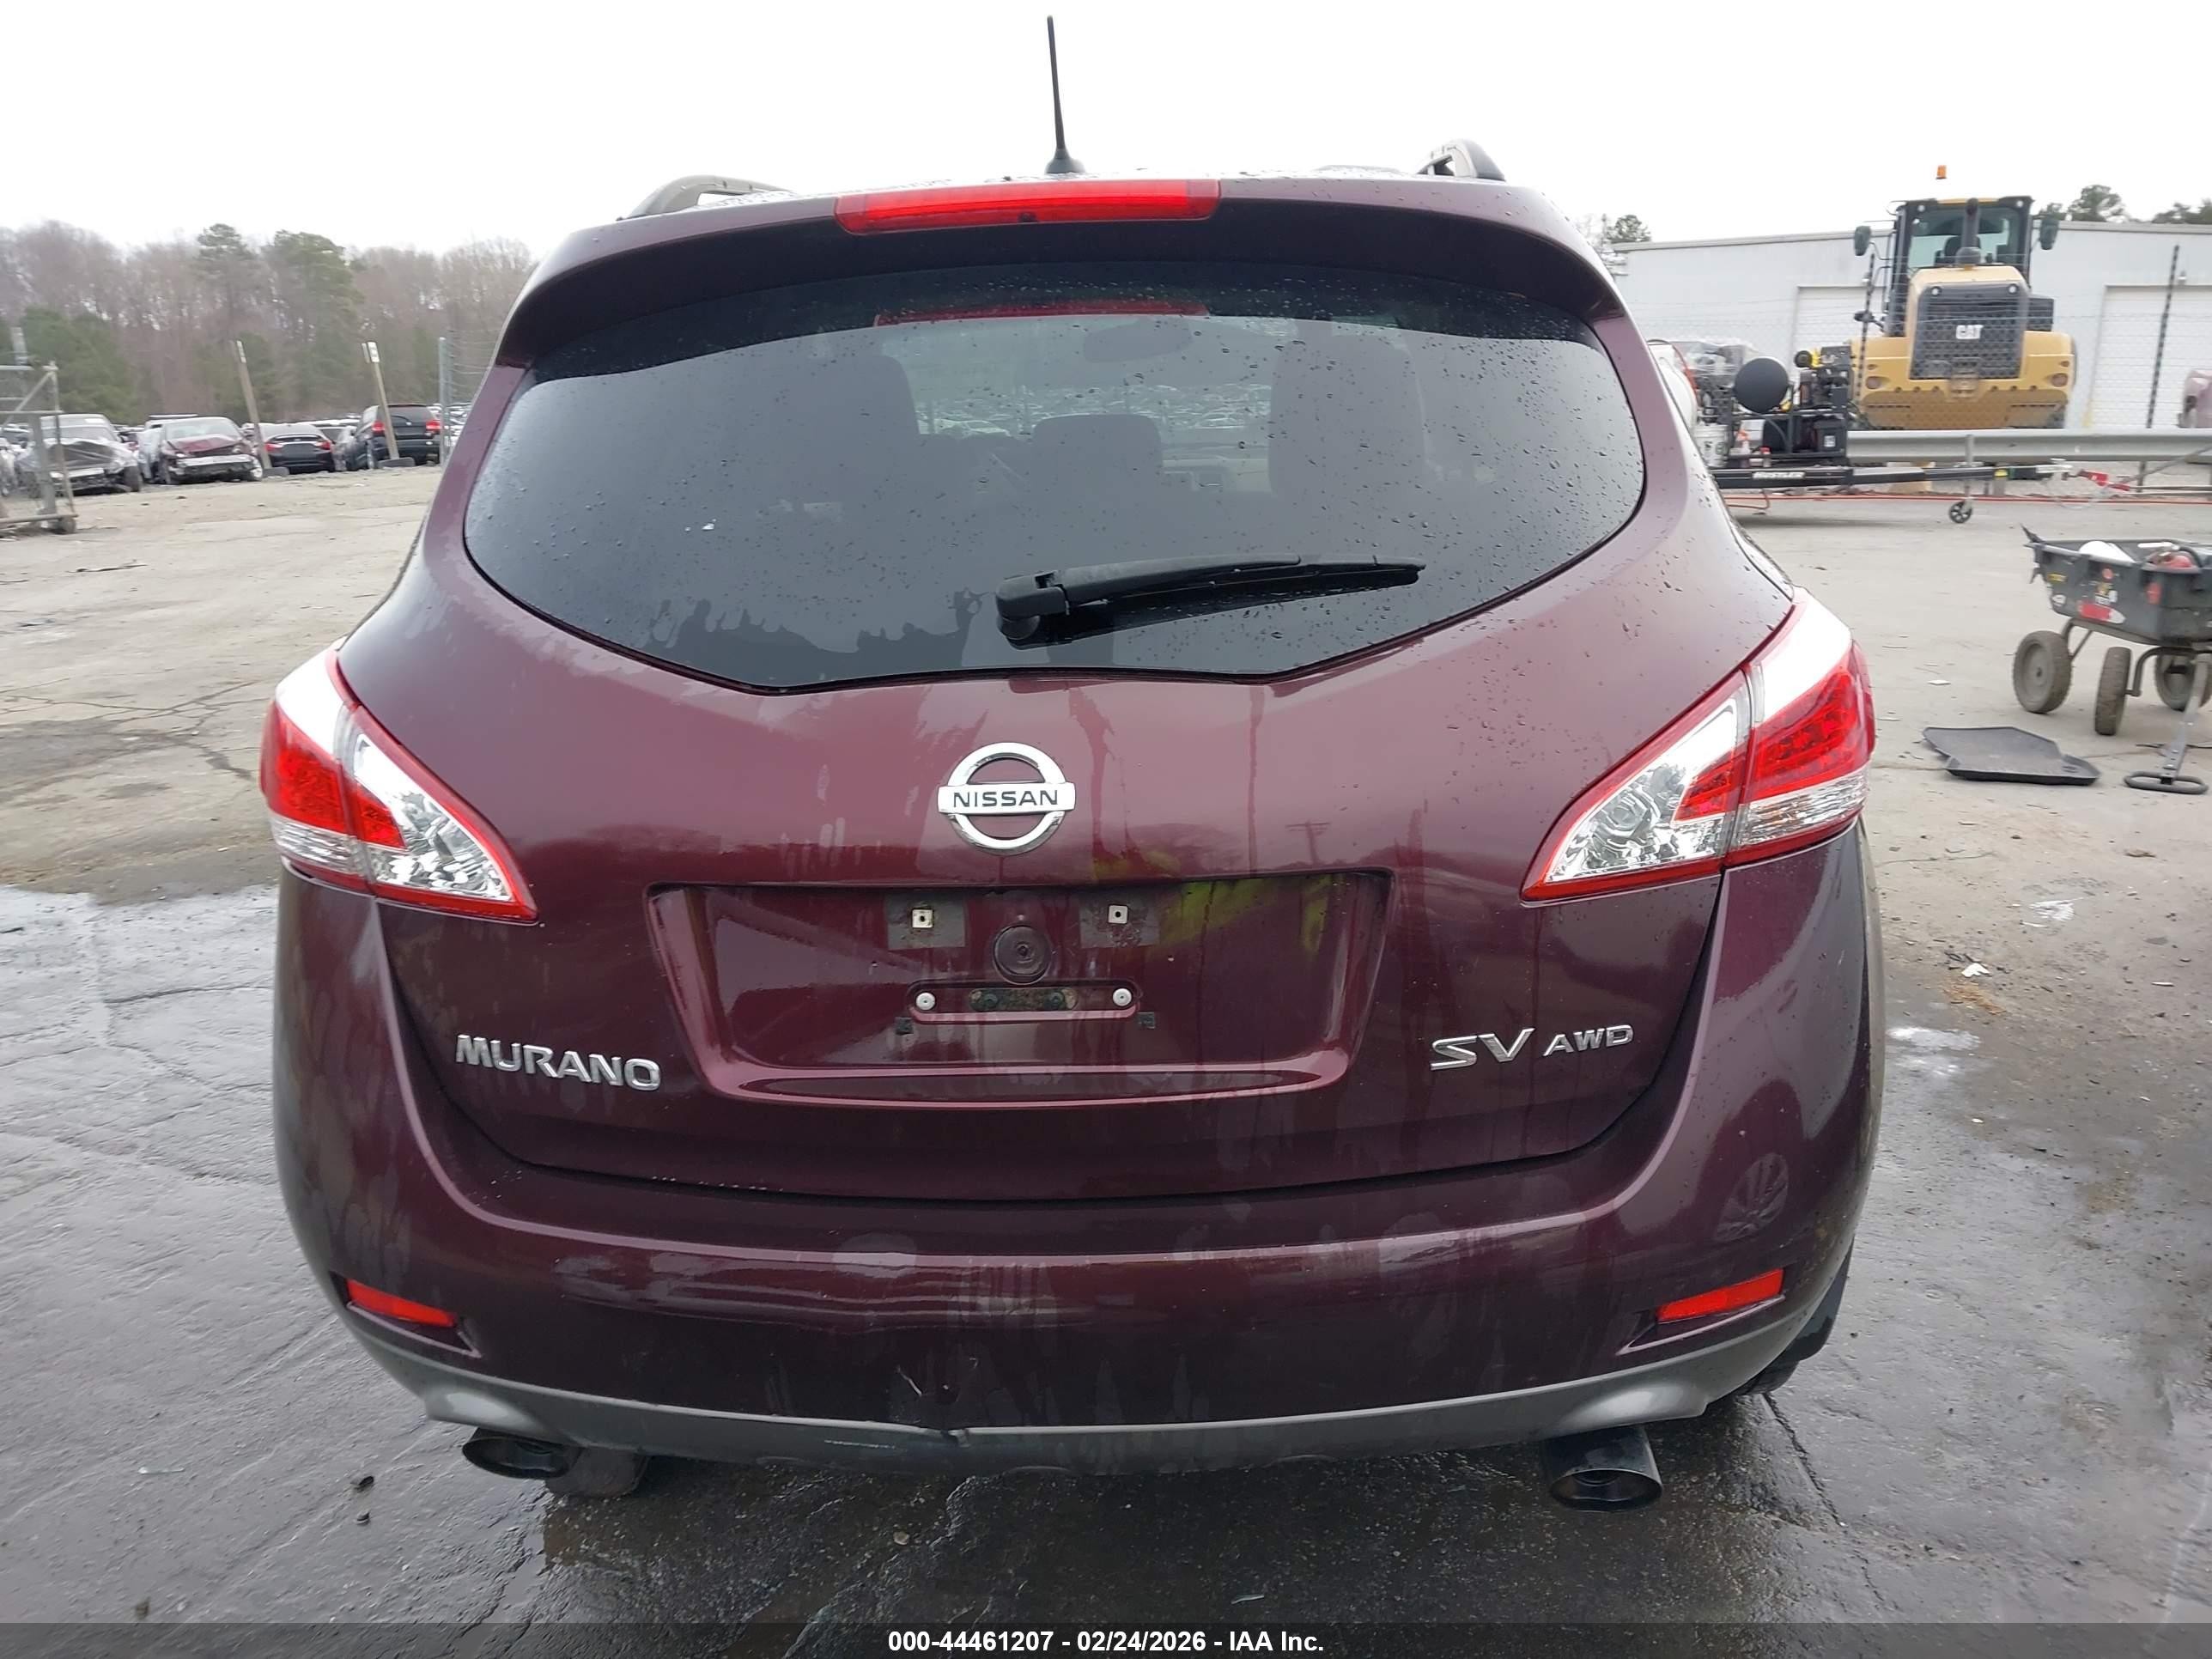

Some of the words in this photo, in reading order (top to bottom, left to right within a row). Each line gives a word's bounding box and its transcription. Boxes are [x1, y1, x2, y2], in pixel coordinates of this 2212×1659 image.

[953, 790, 1058, 808] NISSAN
[455, 1034, 661, 1091] MURANO
[1431, 1028, 1535, 1070] SV
[1542, 1024, 1633, 1056] AWD
